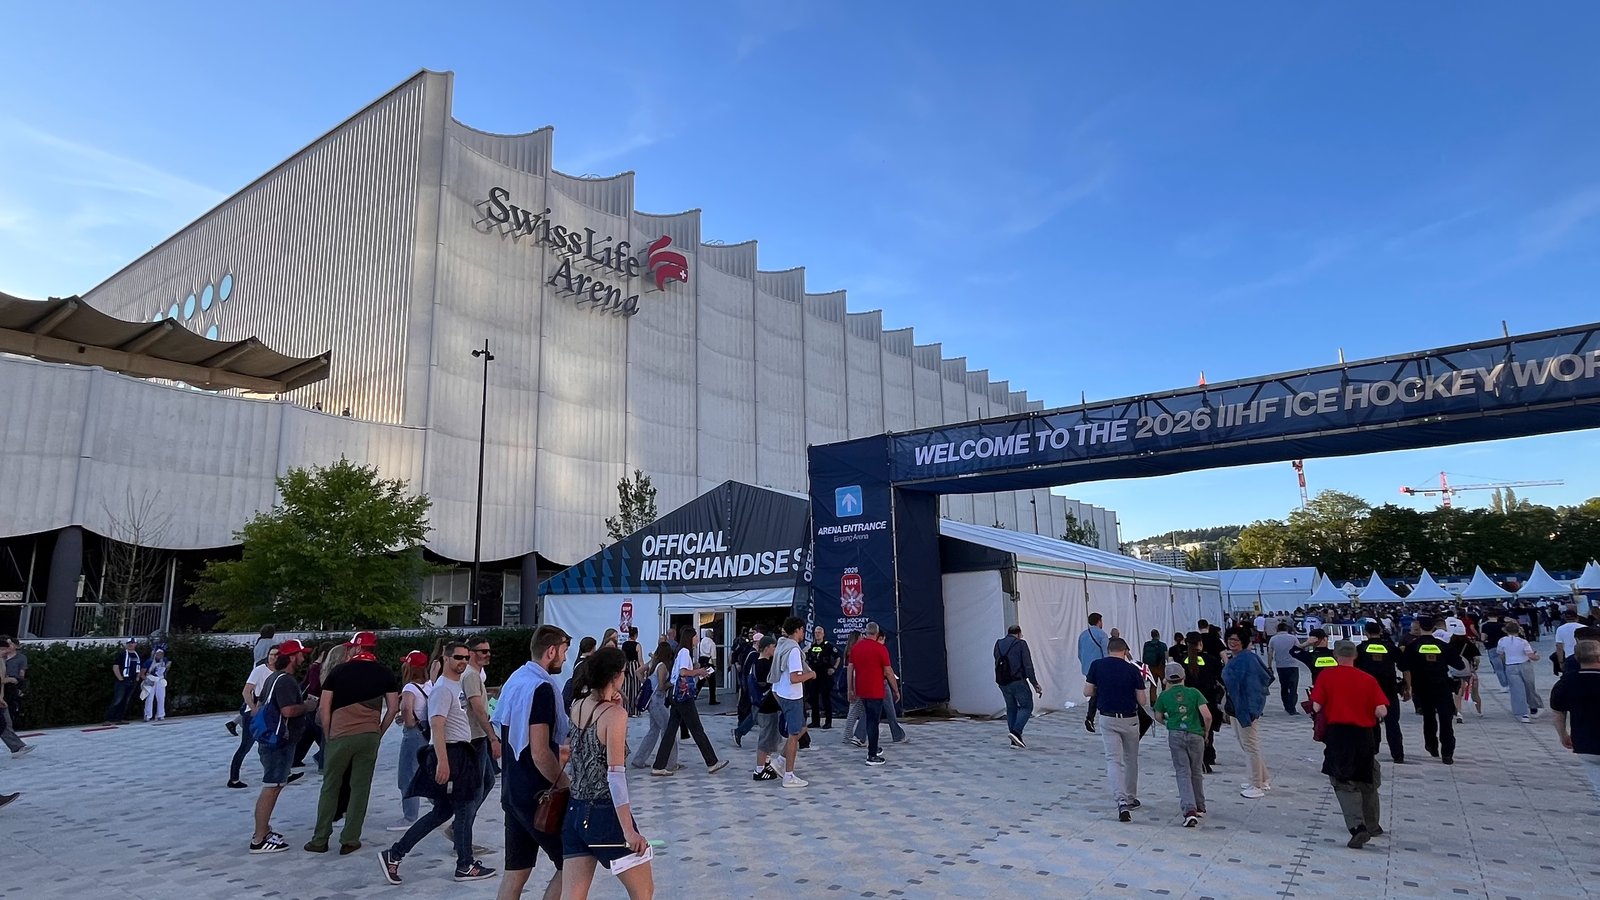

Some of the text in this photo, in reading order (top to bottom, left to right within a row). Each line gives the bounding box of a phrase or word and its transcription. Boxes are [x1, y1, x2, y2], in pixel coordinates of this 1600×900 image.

[547, 257, 640, 317] Arena
[914, 432, 1031, 466] WELCOME
[1034, 427, 1070, 452] TO
[1074, 417, 1129, 446] THE
[1134, 406, 1212, 439] 2026
[1217, 396, 1280, 428] IIHF
[1283, 387, 1340, 419] ICE
[1344, 363, 1506, 411] HOCKEY
[817, 520, 887, 535] ARENA ENTRANCE
[853, 533, 869, 541] Arena
[641, 530, 728, 557] OFFICIAL
[640, 550, 790, 581] MERCHANDISE
[843, 566, 859, 574] 2026
[844, 578, 859, 586] IIHF
